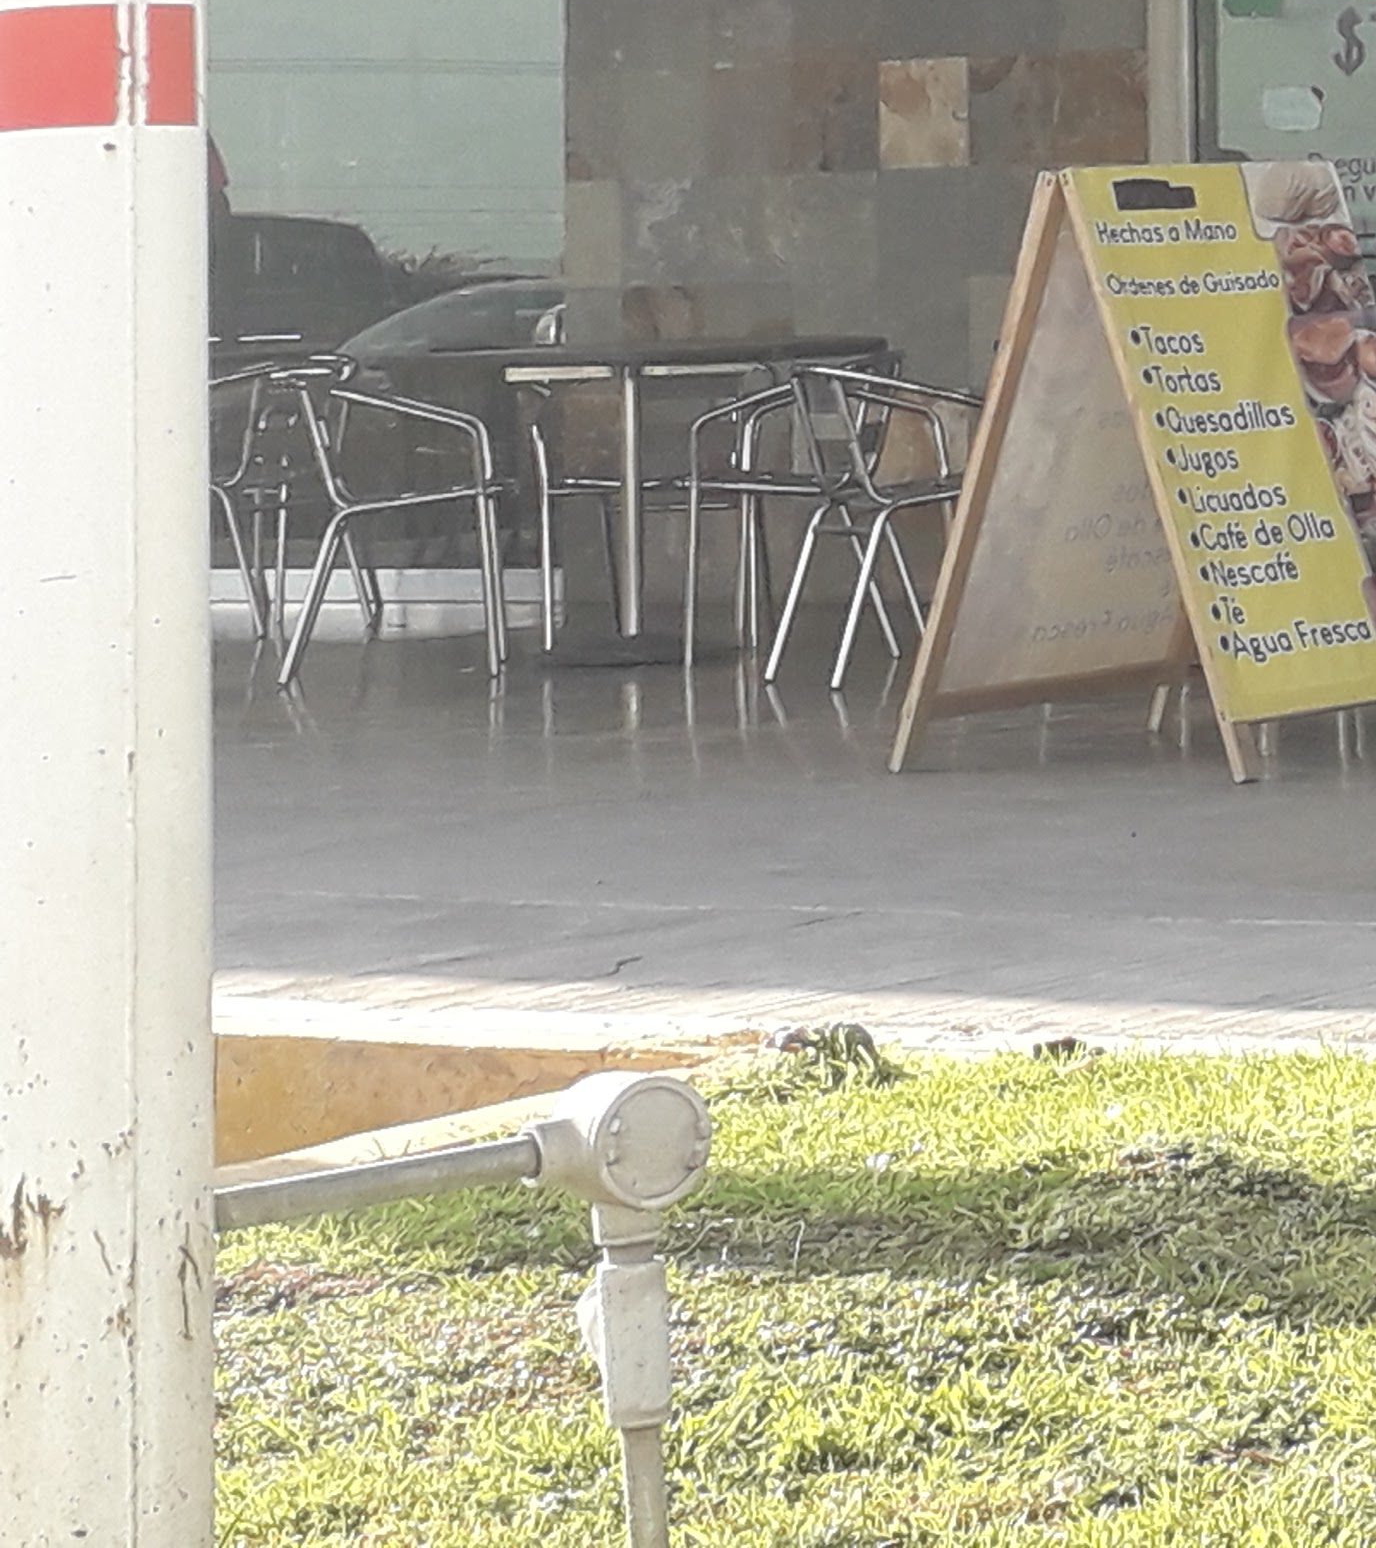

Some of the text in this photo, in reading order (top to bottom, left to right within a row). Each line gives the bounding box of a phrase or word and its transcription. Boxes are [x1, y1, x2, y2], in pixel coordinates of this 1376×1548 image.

[1095, 220, 1165, 244] Hechas
[1183, 217, 1237, 241] Mano
[1106, 269, 1280, 297] Ordenes de Guisado
[1139, 326, 1205, 355] Tacos
[1151, 365, 1222, 394] Tortas
[1165, 400, 1296, 434] Quesadillas
[1178, 443, 1240, 479] Jugos
[1187, 482, 1287, 514] Licuados
[1254, 518, 1284, 546] de
[1287, 511, 1336, 543] Olla
[1232, 619, 1372, 663] Agua Fresca
